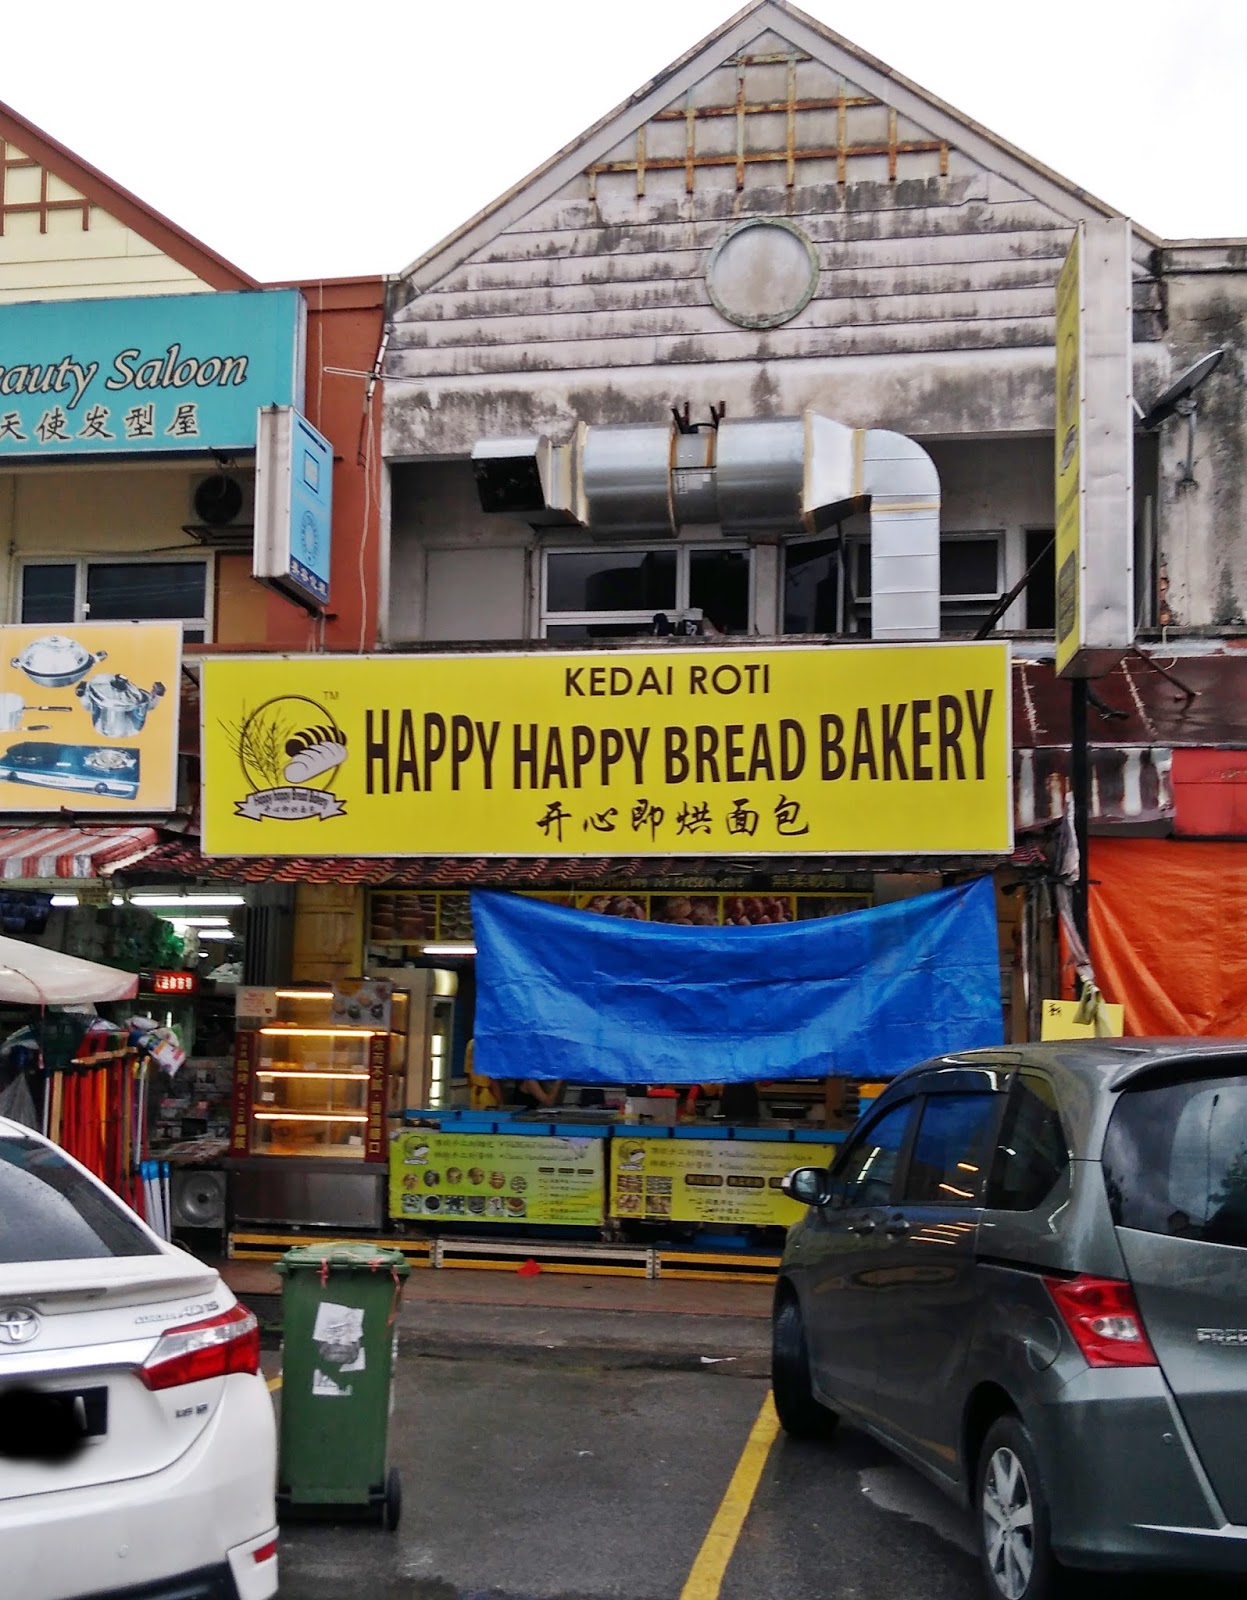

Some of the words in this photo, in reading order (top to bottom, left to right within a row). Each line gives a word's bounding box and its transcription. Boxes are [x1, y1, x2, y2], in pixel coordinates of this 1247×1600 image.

[105, 342, 249, 391] Saloon
[0, 404, 198, 442] 天使发型屋
[566, 666, 673, 696] KEDAI
[690, 664, 770, 695] ROTI
[366, 709, 501, 794] HAPPY
[513, 724, 651, 790] HAPPY
[664, 718, 806, 784] BREAD
[820, 688, 994, 781] BAKERY
[536, 793, 809, 843] 开心即烘面包
